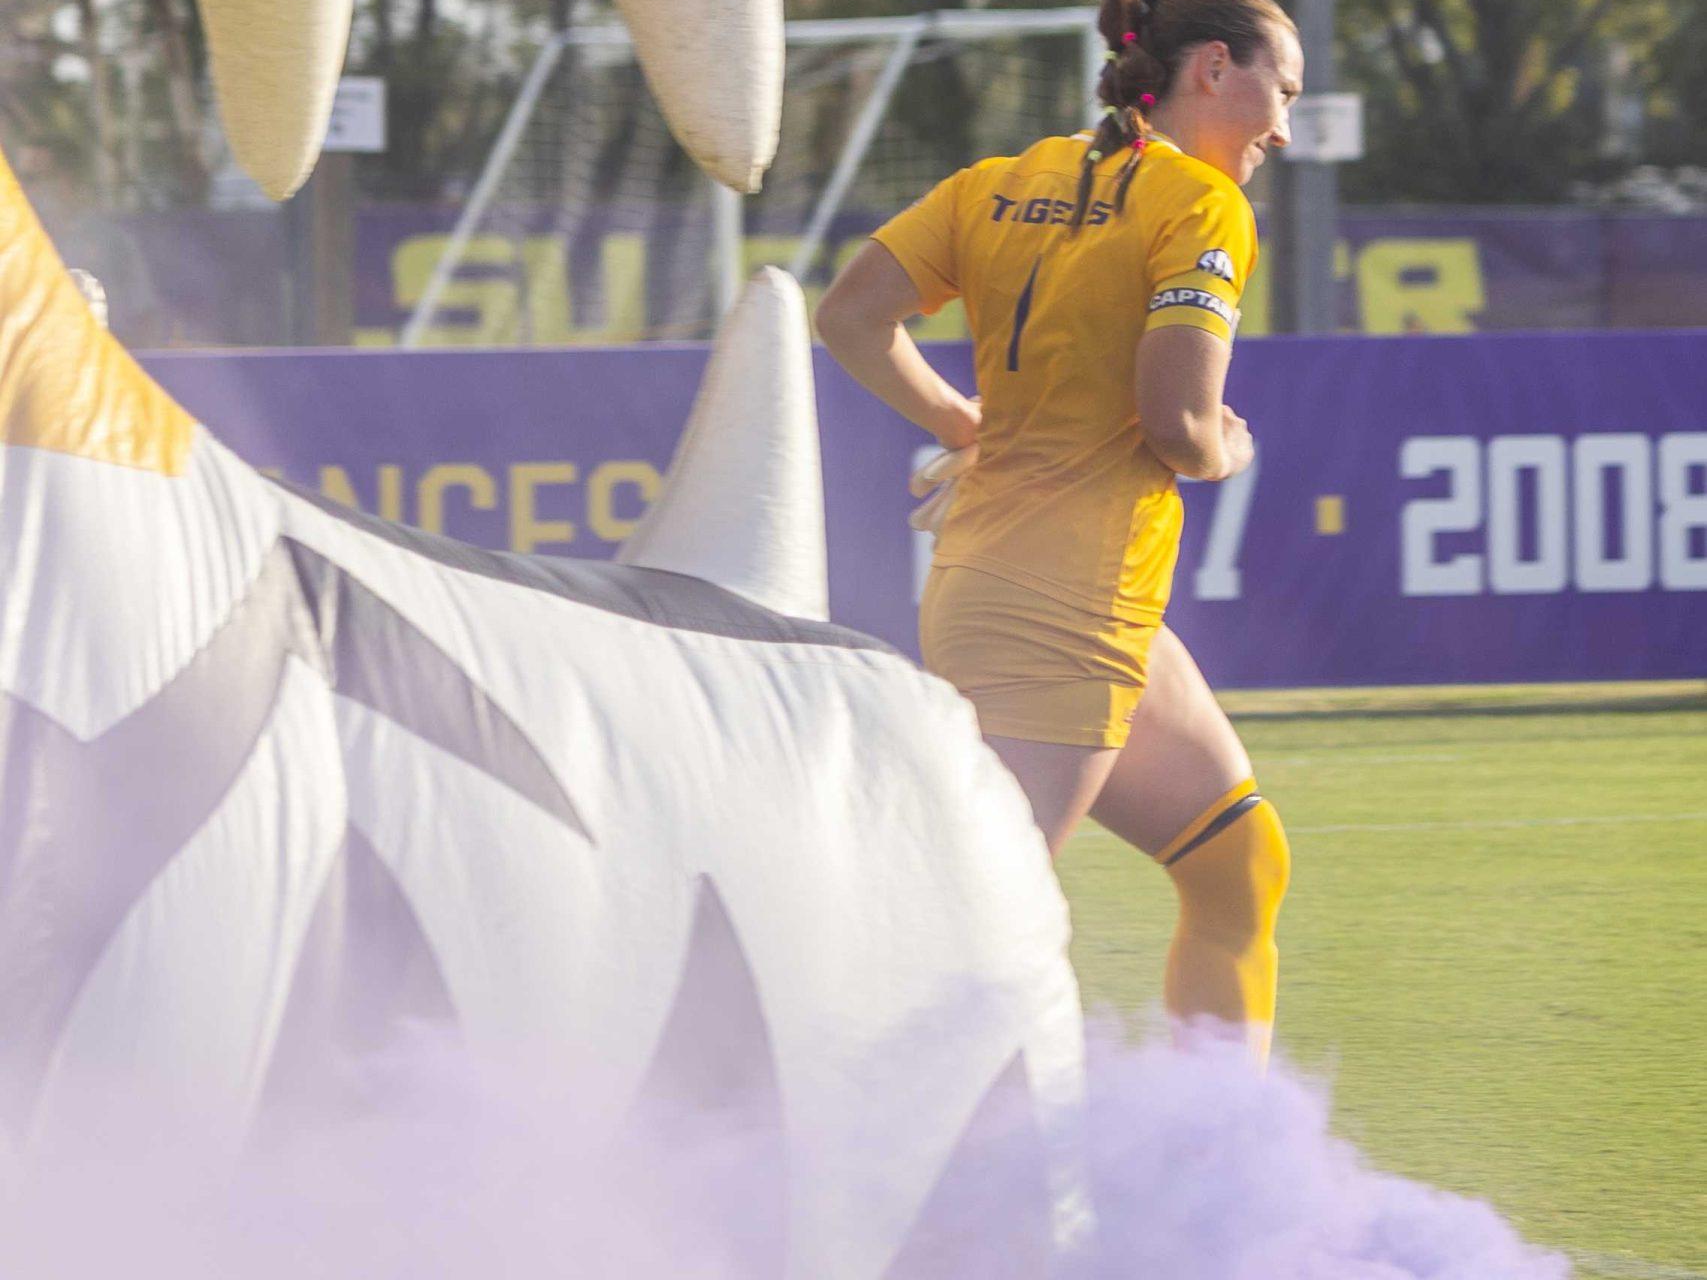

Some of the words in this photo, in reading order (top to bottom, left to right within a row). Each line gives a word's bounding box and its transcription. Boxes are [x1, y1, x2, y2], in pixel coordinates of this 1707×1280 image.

[992, 194, 1115, 225] TIGES
[1149, 290, 1233, 324] CAPTA
[1401, 432, 1707, 597] 2008
